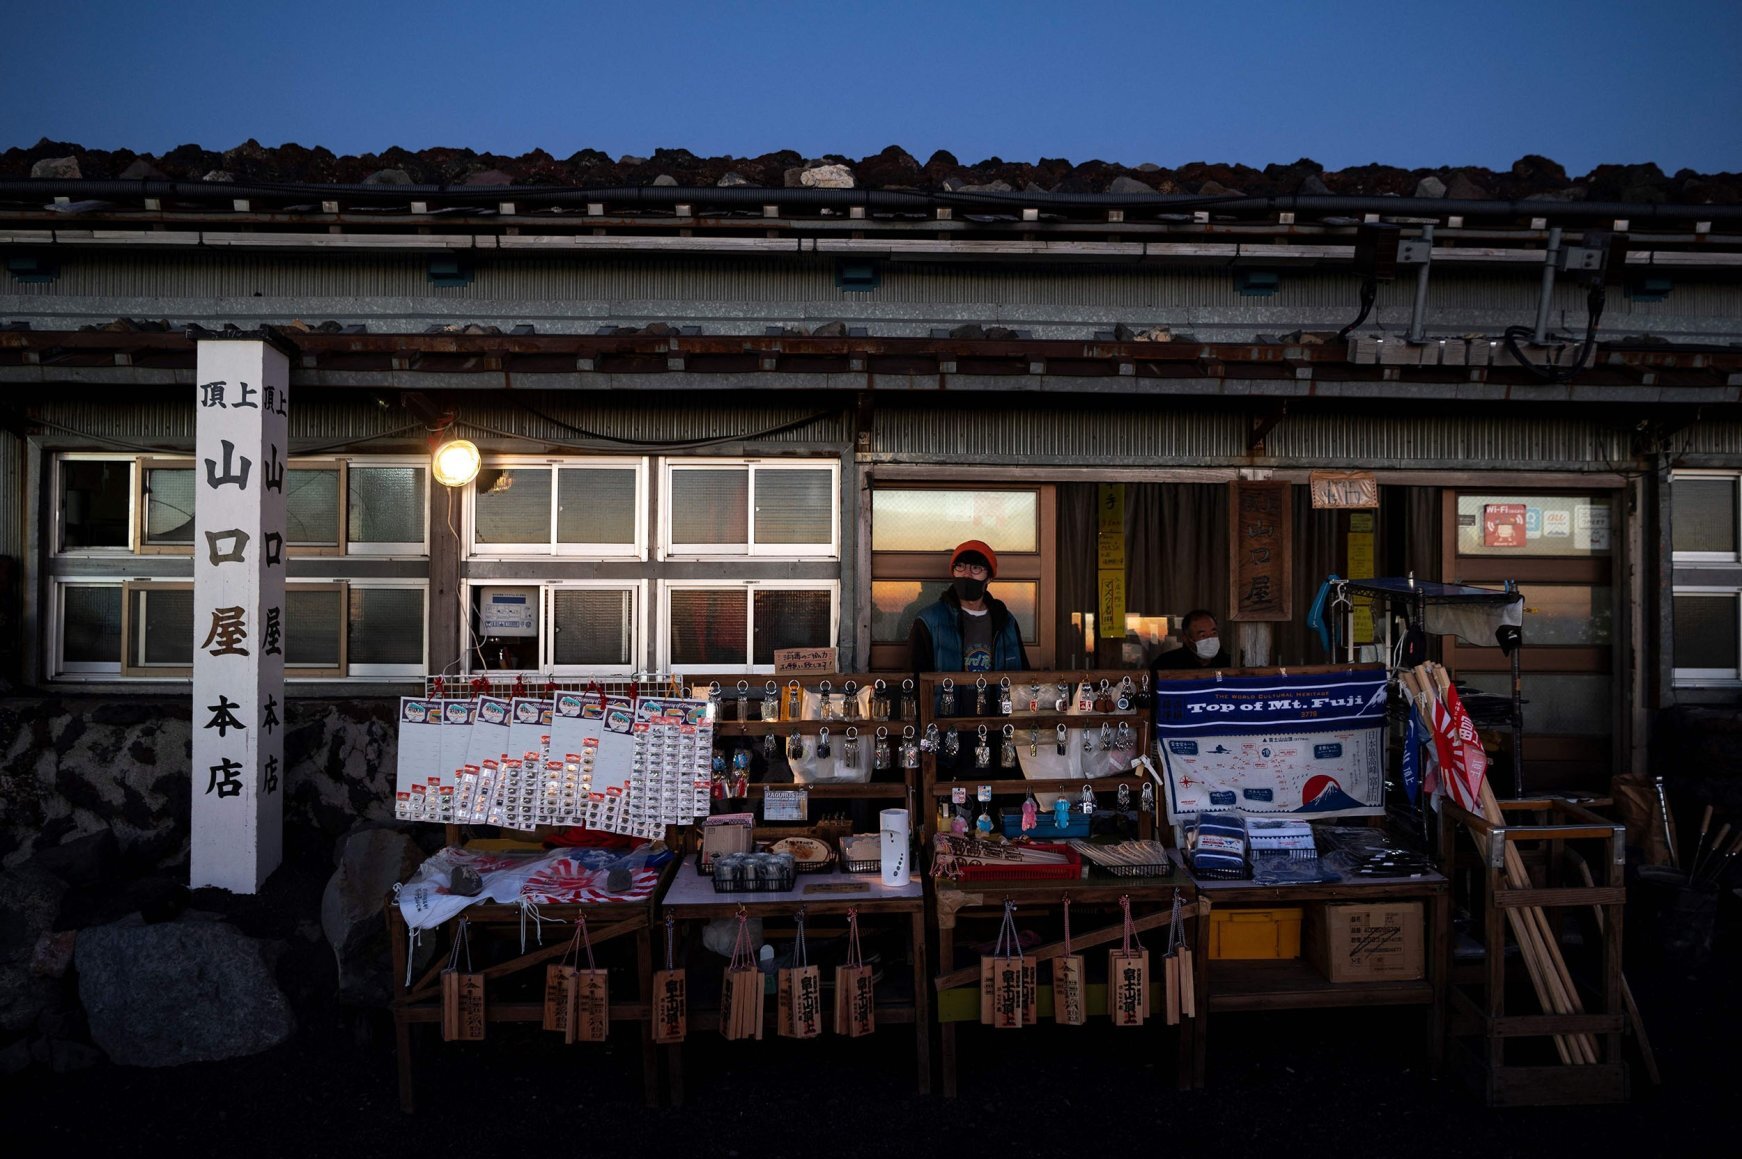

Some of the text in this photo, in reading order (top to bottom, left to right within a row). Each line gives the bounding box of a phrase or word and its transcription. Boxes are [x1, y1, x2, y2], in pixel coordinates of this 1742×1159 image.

[200, 381, 258, 408] 頂上
[263, 386, 287, 417] 頂上
[201, 439, 252, 798] 山口屋本店
[262, 443, 284, 795] 山口屋本店
[1187, 703, 1236, 714] Top
[1239, 701, 1264, 711] of
[1268, 699, 1307, 711] Mt.
[1311, 695, 1364, 709] Fuji
